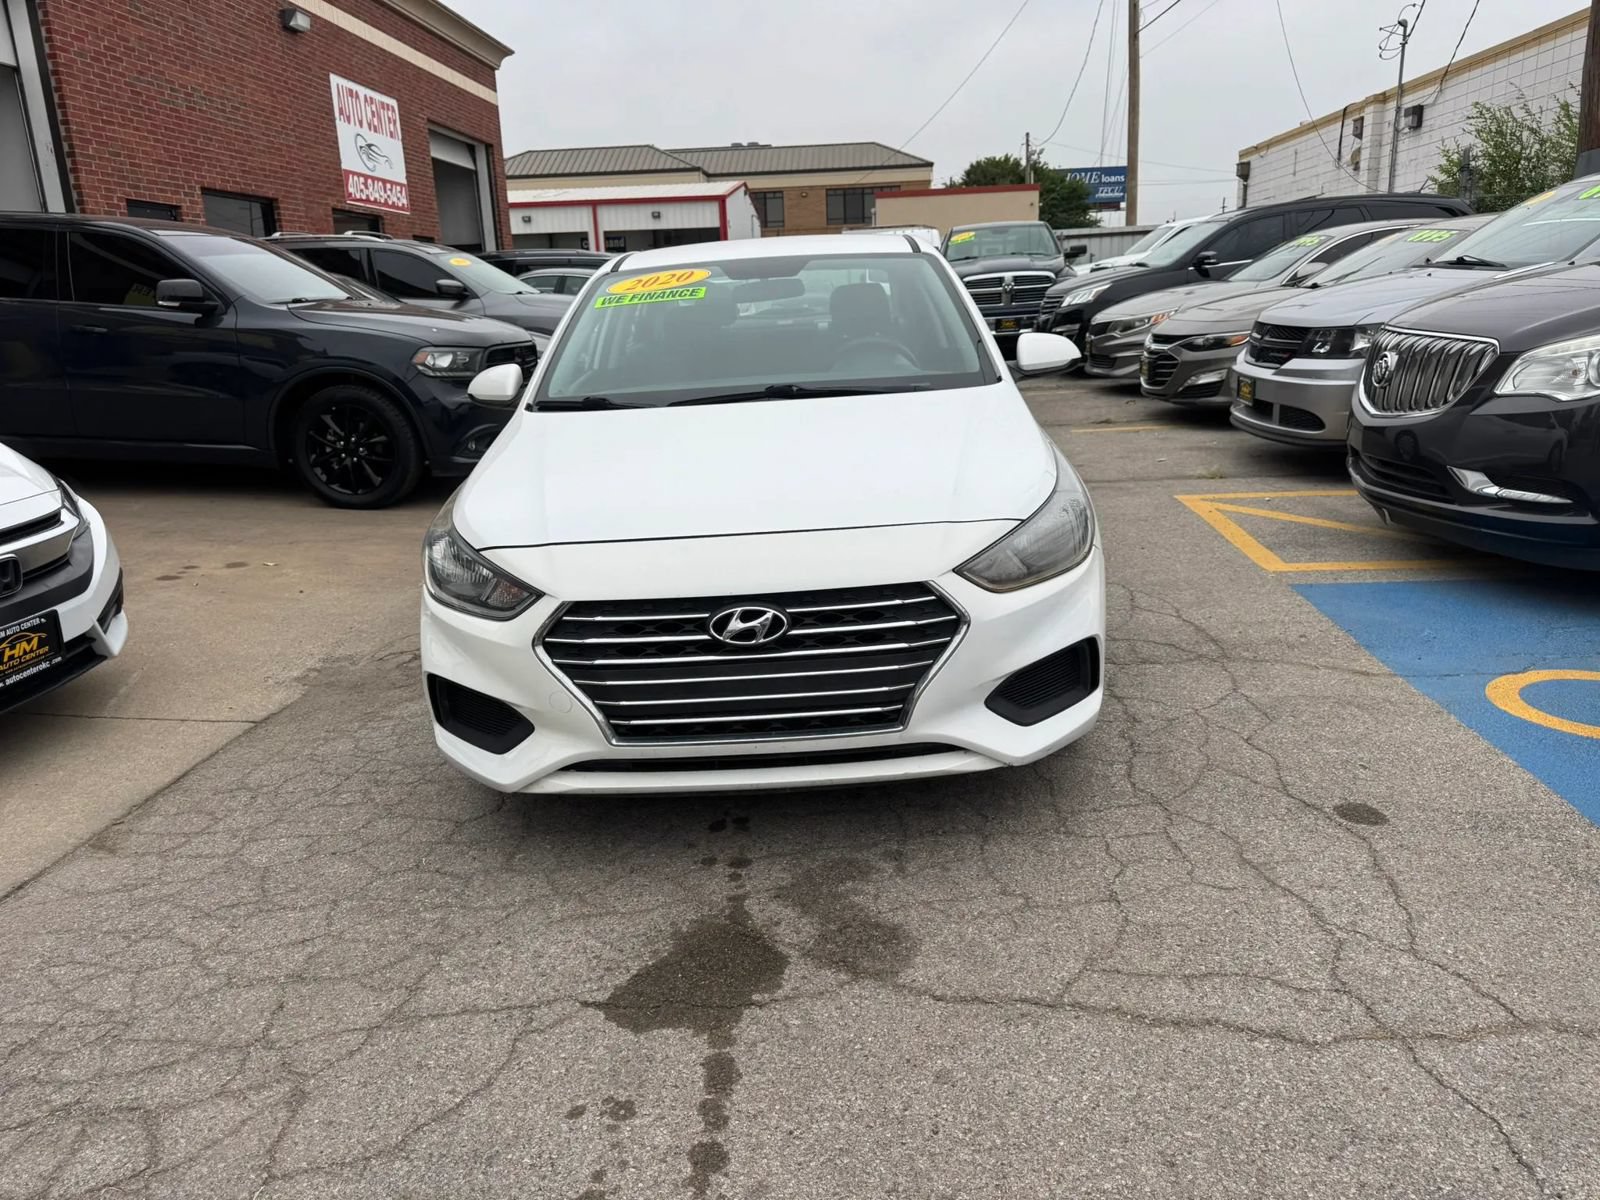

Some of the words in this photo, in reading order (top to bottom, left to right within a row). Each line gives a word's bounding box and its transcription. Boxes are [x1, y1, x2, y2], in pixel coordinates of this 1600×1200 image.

[336, 83, 363, 129] AUTO
[364, 94, 400, 141] CENTER
[1101, 174, 1125, 183] loans
[348, 174, 408, 208] 405-849-5454
[624, 271, 695, 291] 2020
[602, 295, 626, 305] WE
[628, 288, 701, 302] FINANCE
[6, 625, 20, 636] AUTO
[20, 617, 41, 630] CENTER
[4, 636, 39, 662] HM
[21, 646, 49, 662] CENTER
[5, 661, 50, 685] autocenterokc
